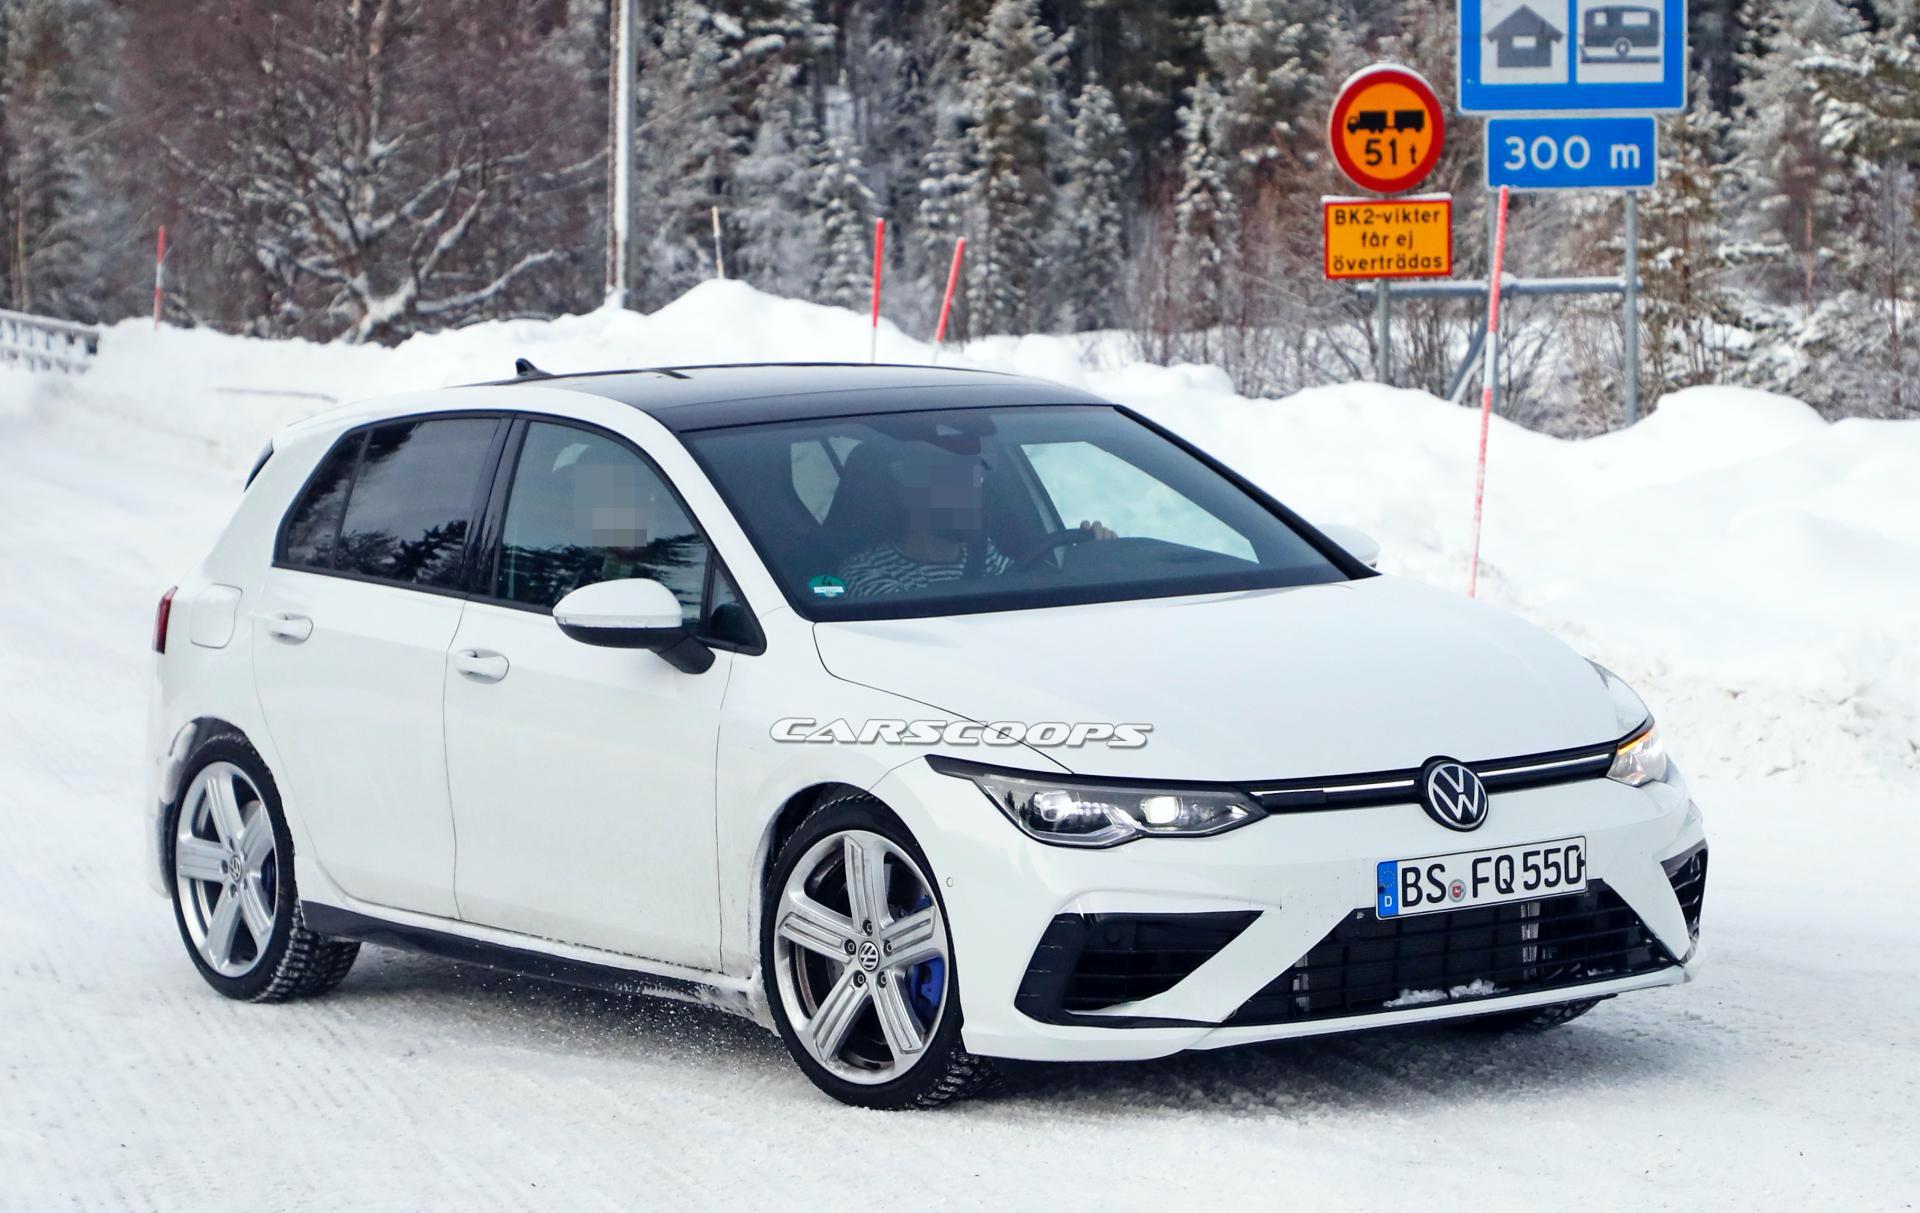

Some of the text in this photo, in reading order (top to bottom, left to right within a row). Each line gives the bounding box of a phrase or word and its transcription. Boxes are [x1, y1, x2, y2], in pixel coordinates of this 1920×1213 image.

[1365, 139, 1418, 166] 51 t
[1504, 136, 1641, 171] 300 m
[1334, 208, 1441, 226] BK2-vikter
[1361, 230, 1413, 249] får ej
[1334, 254, 1443, 272] överträdas
[1401, 844, 1583, 908] BS FQ 550
[1384, 896, 1393, 907] D
